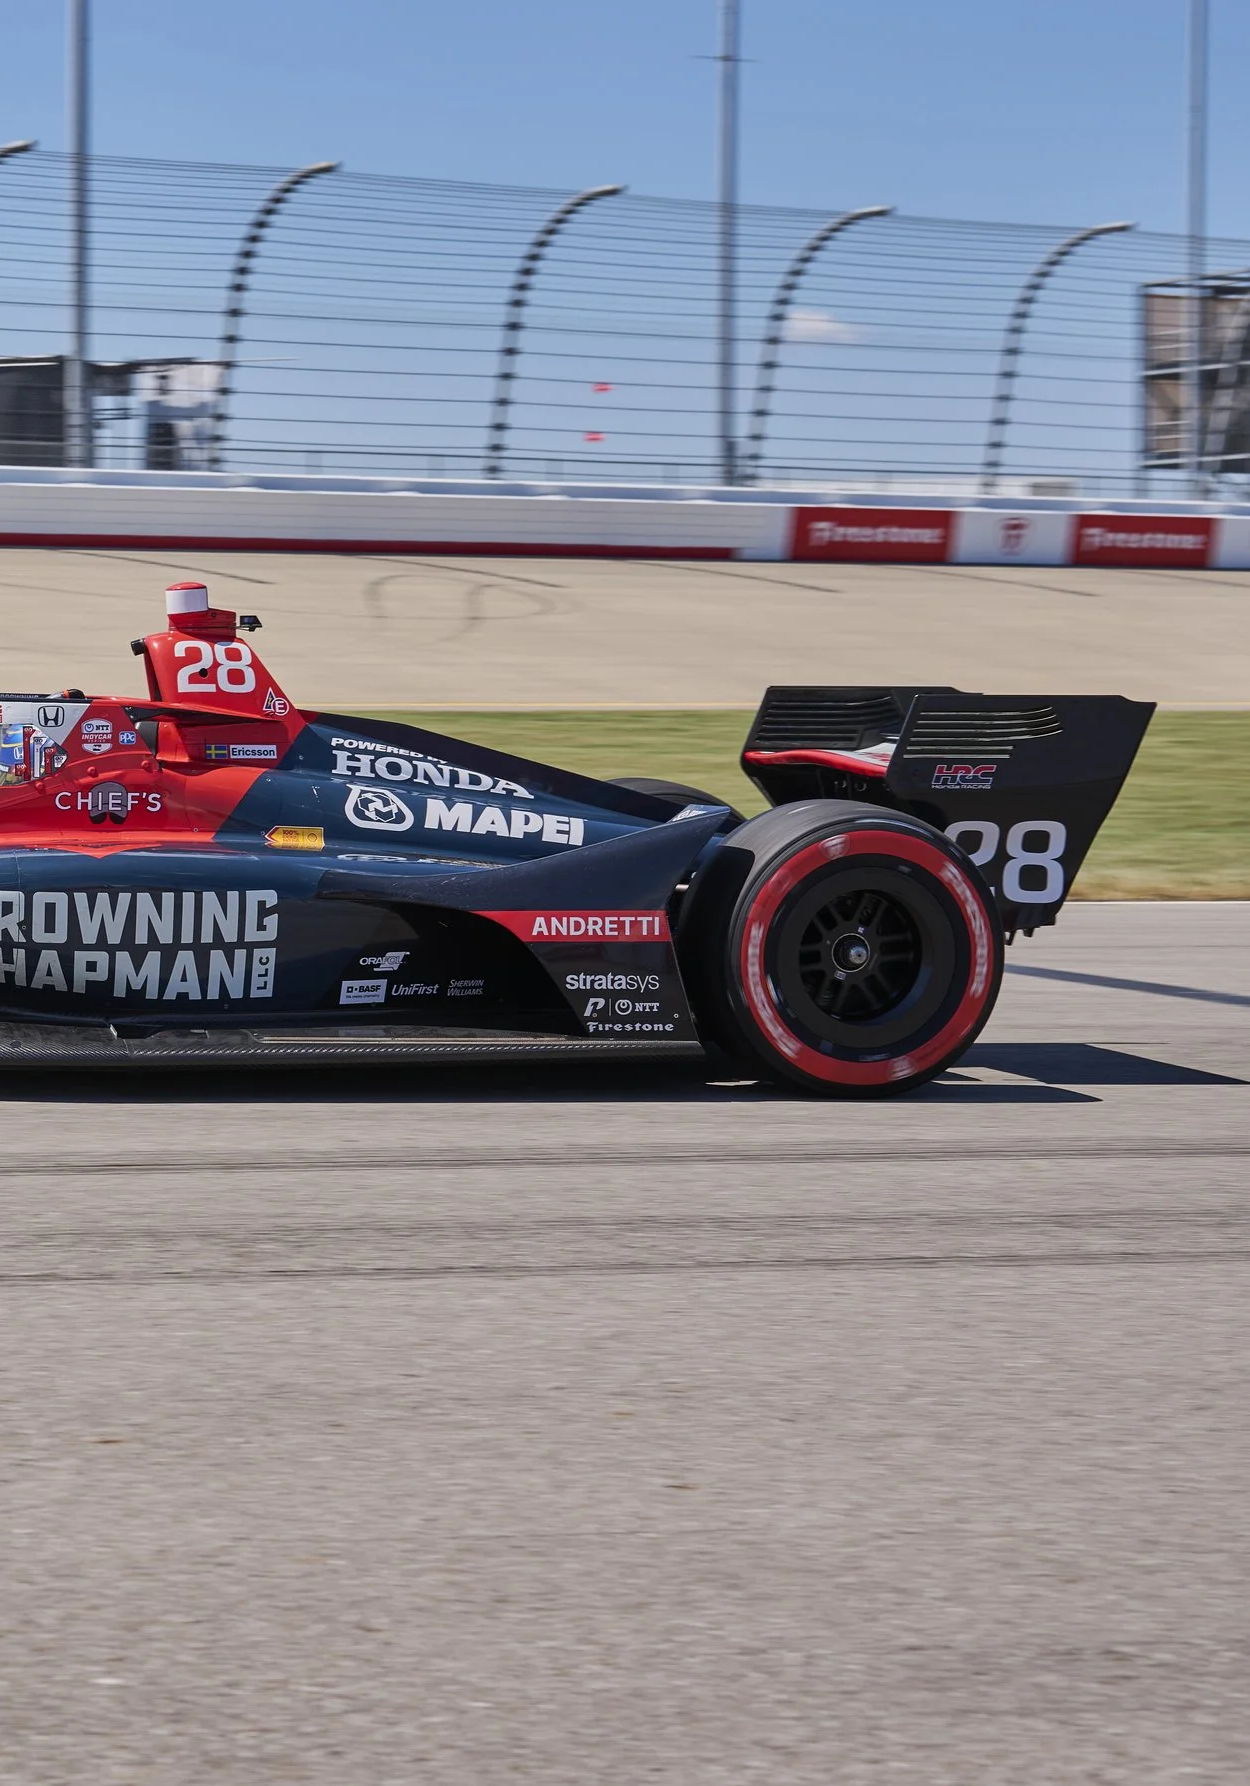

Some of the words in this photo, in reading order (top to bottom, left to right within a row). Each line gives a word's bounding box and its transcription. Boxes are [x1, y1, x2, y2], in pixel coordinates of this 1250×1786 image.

[174, 640, 256, 693] 28
[120, 733, 135, 743] PPG
[330, 737, 424, 759] POWERED
[230, 746, 277, 758] Ericsson
[331, 750, 535, 800] HONDA
[932, 764, 997, 785] HRC
[55, 791, 162, 812] CHIEF'S
[424, 798, 586, 846] MAPEI
[531, 916, 660, 936] ANDRETTI
[359, 955, 402, 966] ORAFOL
[256, 955, 270, 990] LLC
[565, 972, 660, 993] stratasys
[359, 985, 382, 993] BASF
[391, 983, 440, 996] UniFirst
[449, 979, 485, 988] SHERWIN
[634, 1002, 660, 1012] NTT
[586, 1021, 674, 1033] Firestone
